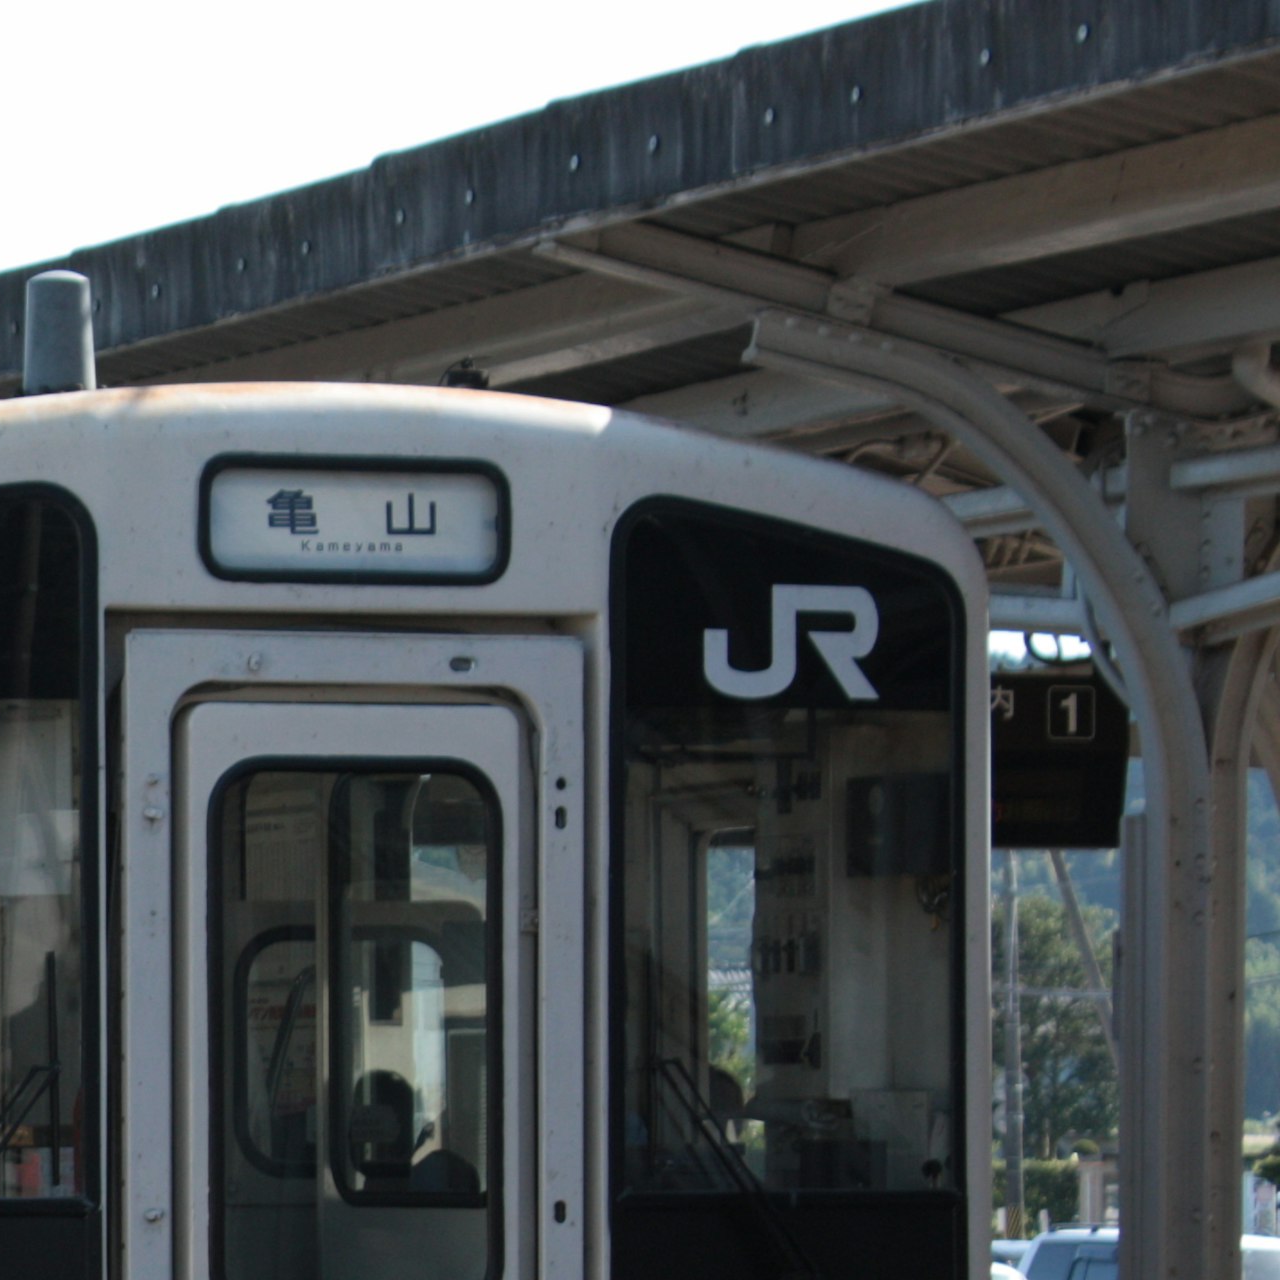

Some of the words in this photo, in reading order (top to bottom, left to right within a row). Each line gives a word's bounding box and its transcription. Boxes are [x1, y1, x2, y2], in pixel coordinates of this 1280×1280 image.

[267, 489, 436, 535] 亀山
[301, 540, 403, 552] Kameyama
[703, 584, 879, 700] JR
[1060, 692, 1077, 734] 1
